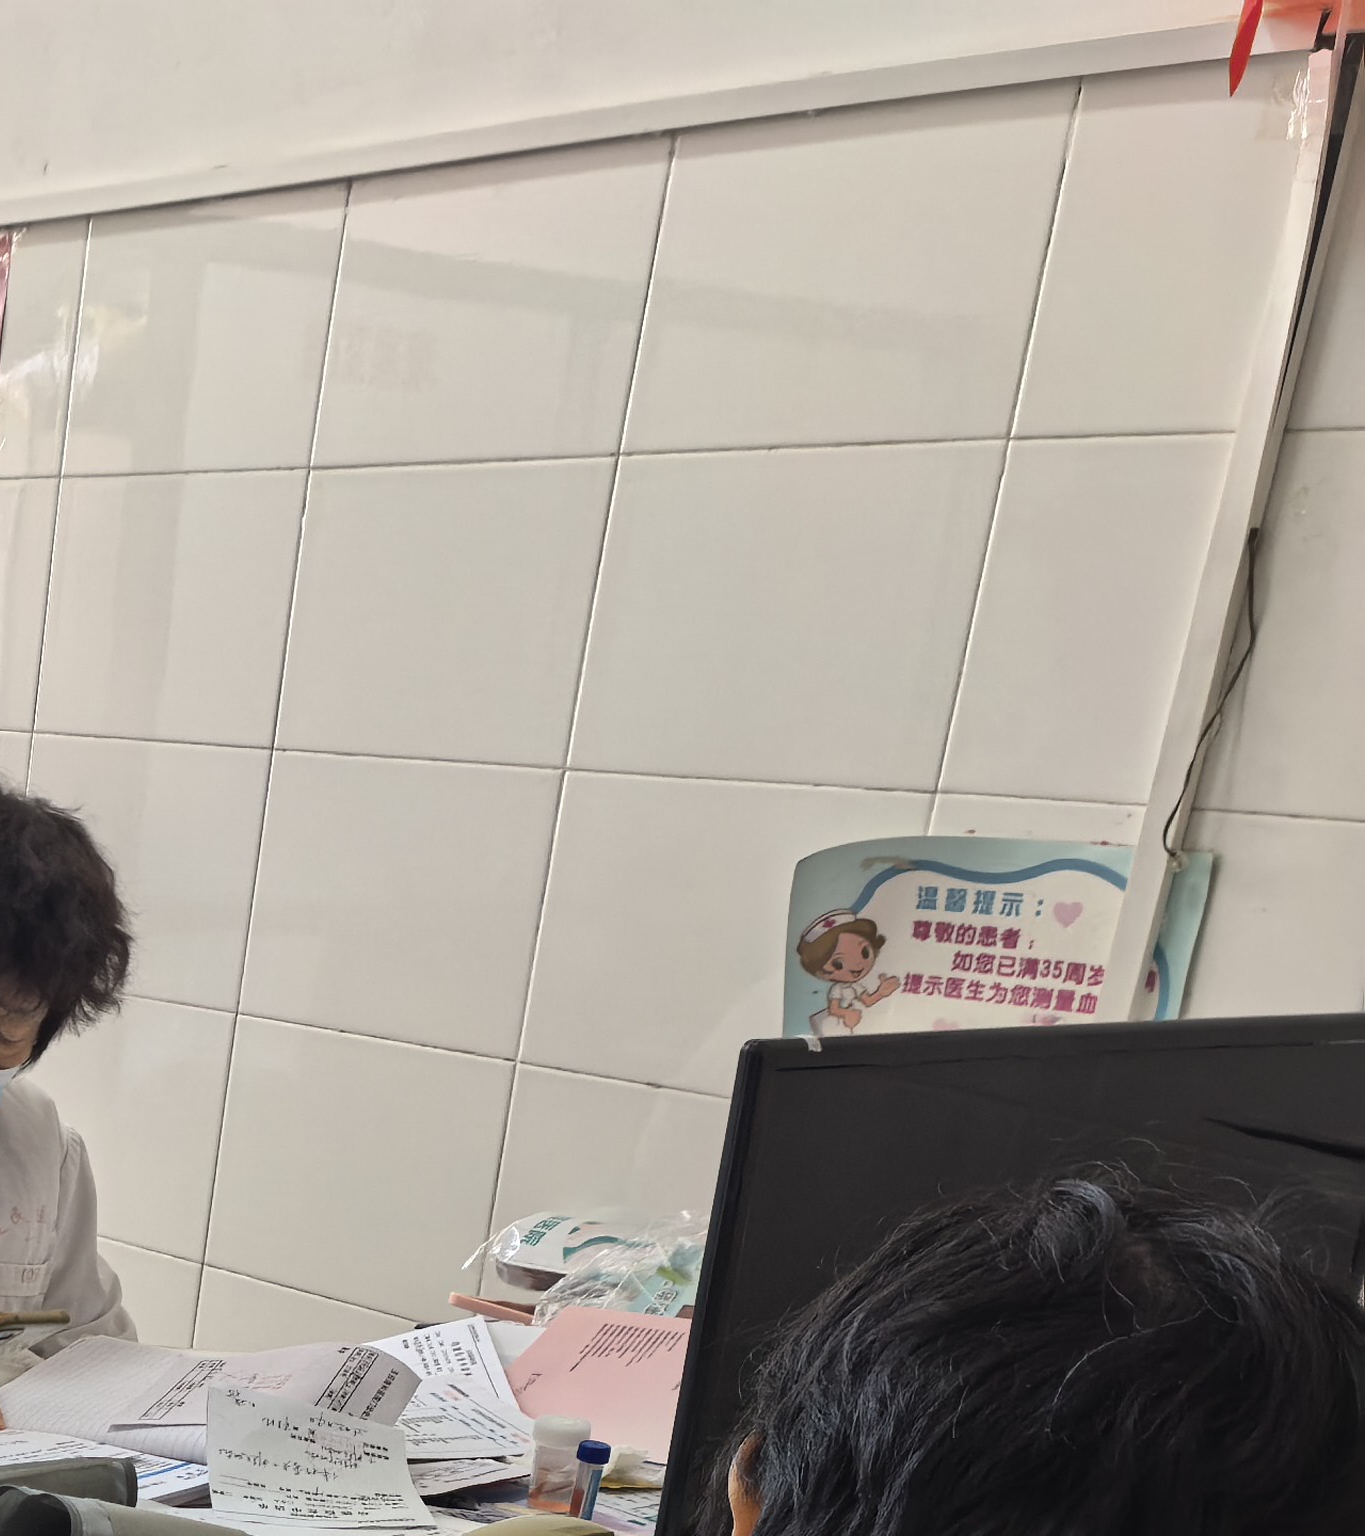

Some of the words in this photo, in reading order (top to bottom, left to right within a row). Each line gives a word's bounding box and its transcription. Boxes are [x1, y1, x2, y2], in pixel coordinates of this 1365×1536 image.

[916, 886, 1045, 918] 温馨提示：
[950, 950, 1105, 987] 如您已满35周岁
[900, 972, 1099, 1015] 提示医生为您测量血
